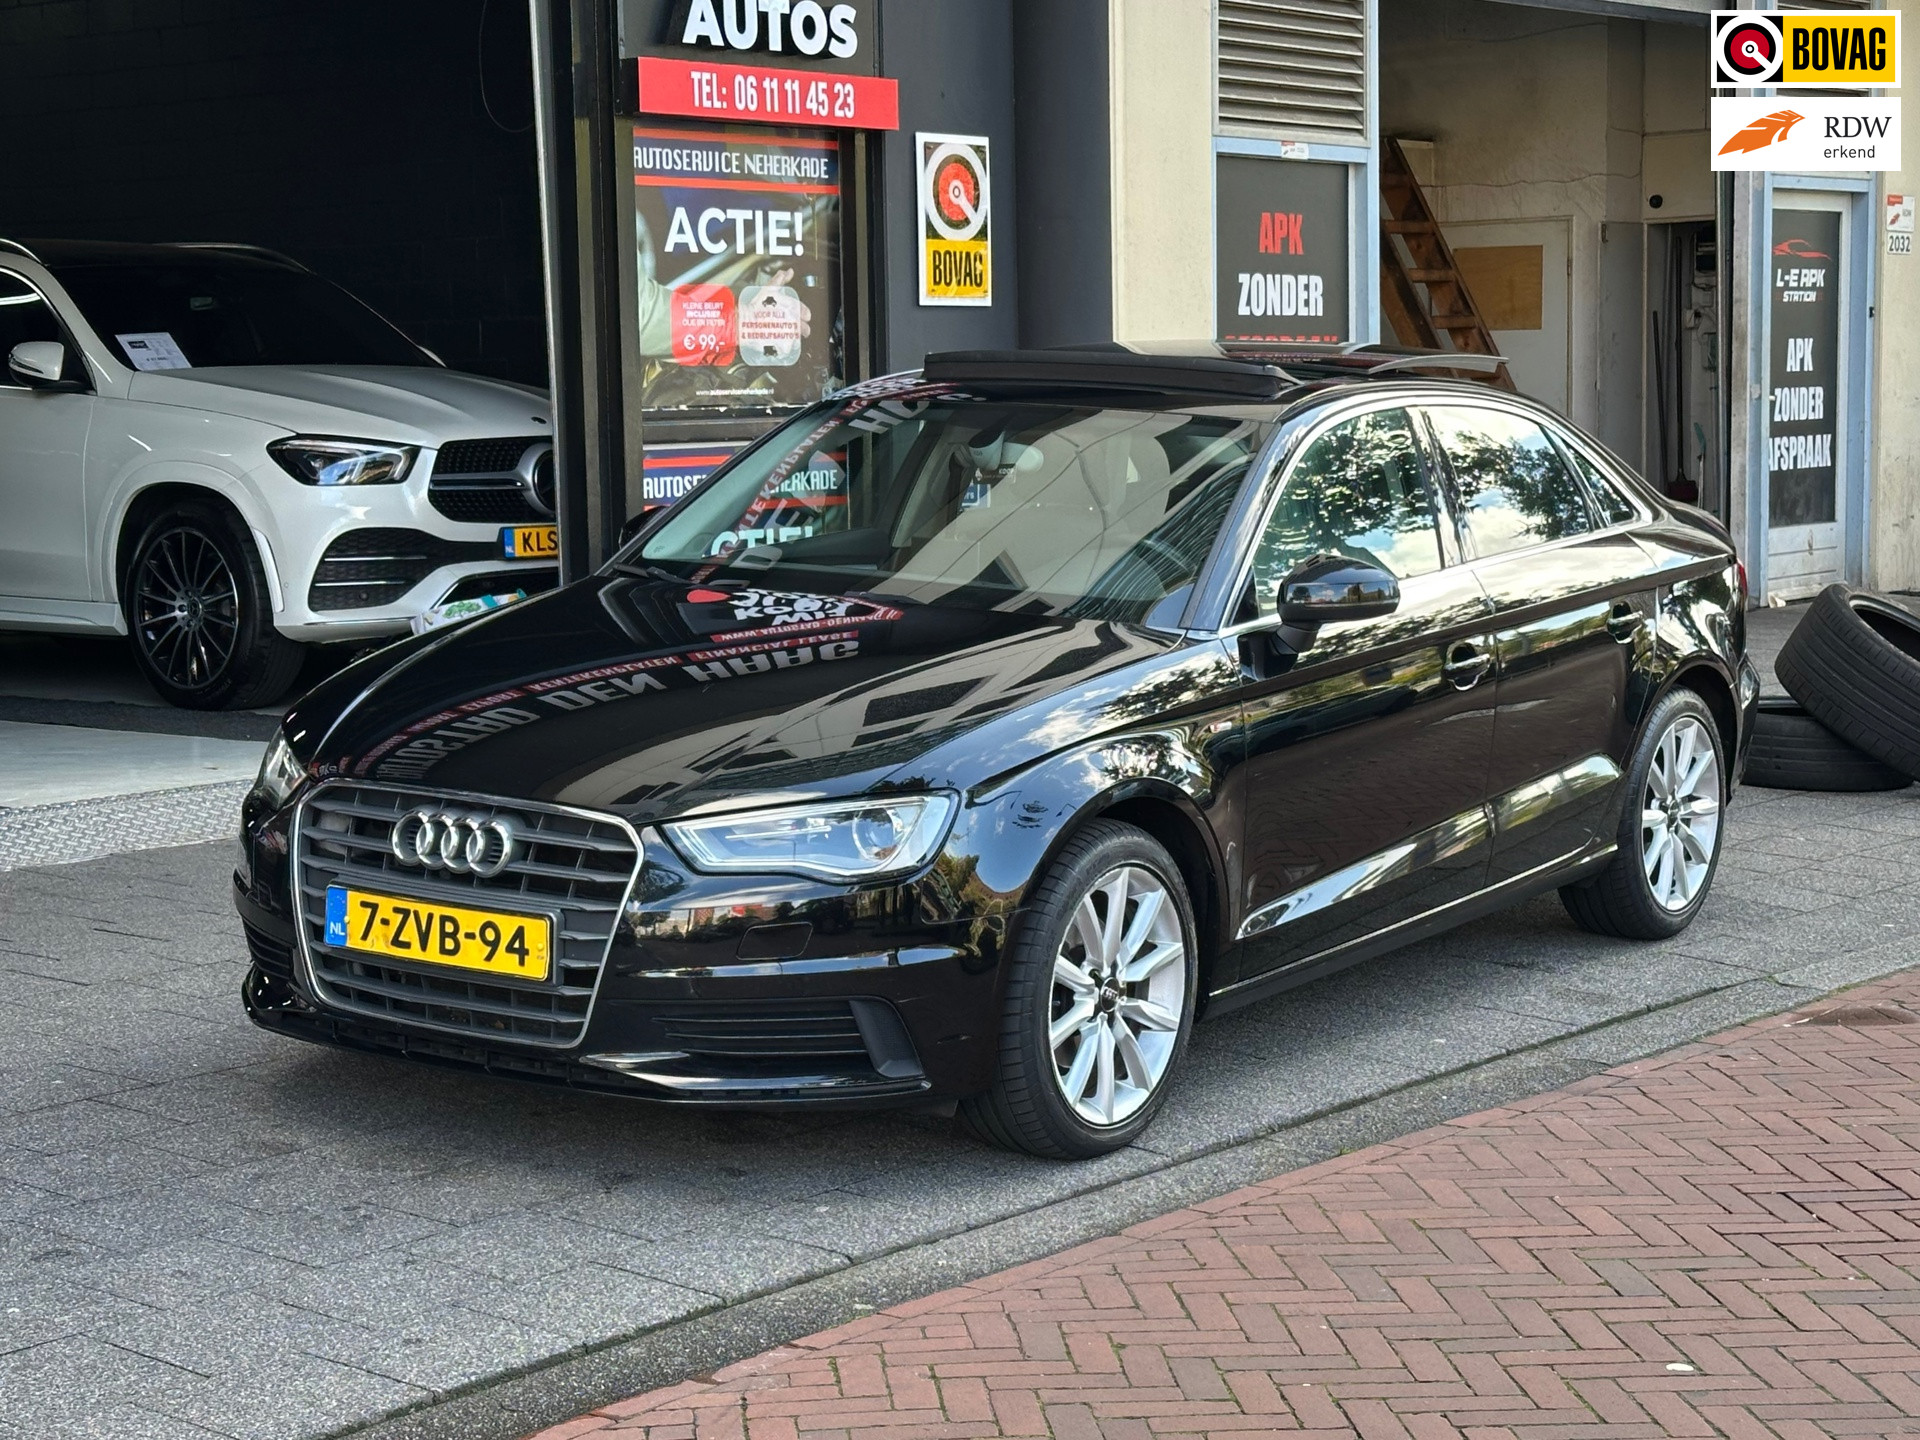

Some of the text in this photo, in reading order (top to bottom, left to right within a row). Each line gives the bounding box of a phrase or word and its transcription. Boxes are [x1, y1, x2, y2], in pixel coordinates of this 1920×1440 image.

[682, 0, 858, 58] AUTOS
[690, 71, 855, 119] TEL: 06 11 11 45 23
[634, 146, 829, 179] AUTOSERVICE NEHERKADE
[664, 206, 804, 257] ACTIE!
[1258, 212, 1304, 255] APK
[1889, 235, 1911, 252] 2032
[932, 249, 983, 288] BOVAG
[1776, 268, 1826, 287] L-E APK
[1237, 272, 1324, 317] ZONDER
[1782, 290, 1817, 302] STATION
[683, 333, 726, 353] € 99,-
[1786, 337, 1814, 372] APK
[1773, 386, 1824, 422] ZONDER
[1768, 433, 1832, 472] AFSPRAAK
[505, 545, 514, 553] NL
[522, 531, 557, 552] KLS
[329, 922, 346, 936] NL
[359, 900, 530, 967] 7-ZVB-94
